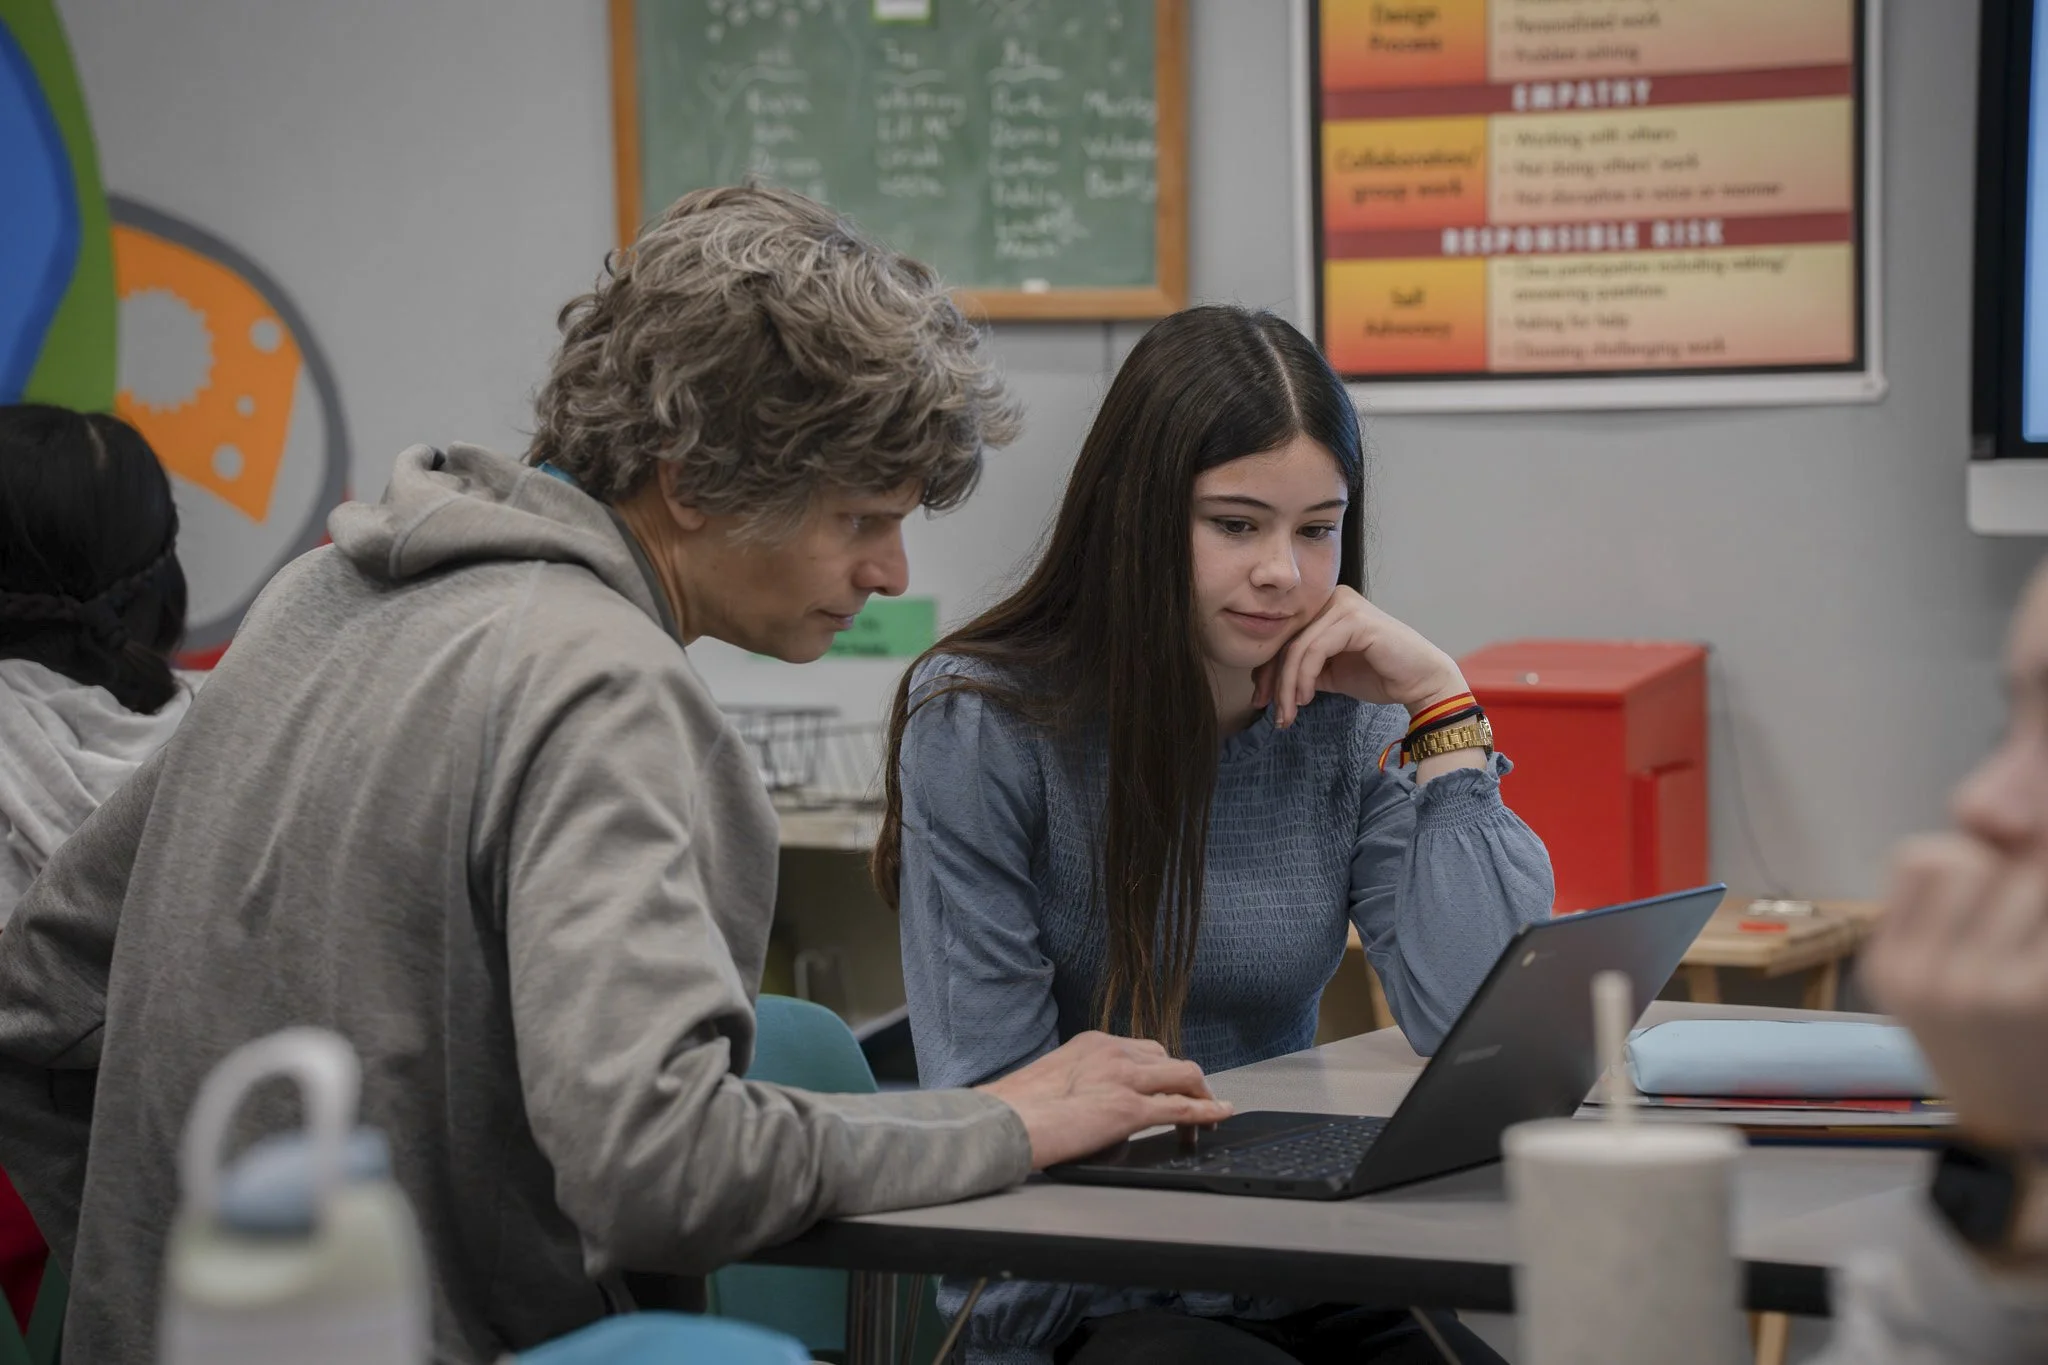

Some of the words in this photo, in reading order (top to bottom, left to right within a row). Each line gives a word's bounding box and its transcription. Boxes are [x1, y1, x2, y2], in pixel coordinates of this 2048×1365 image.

[1512, 79, 1652, 112] EMPATHY
[1418, 177, 1462, 196] work
[1442, 222, 1638, 255] RESPONSIBLE
[1652, 218, 1724, 249] RISK
